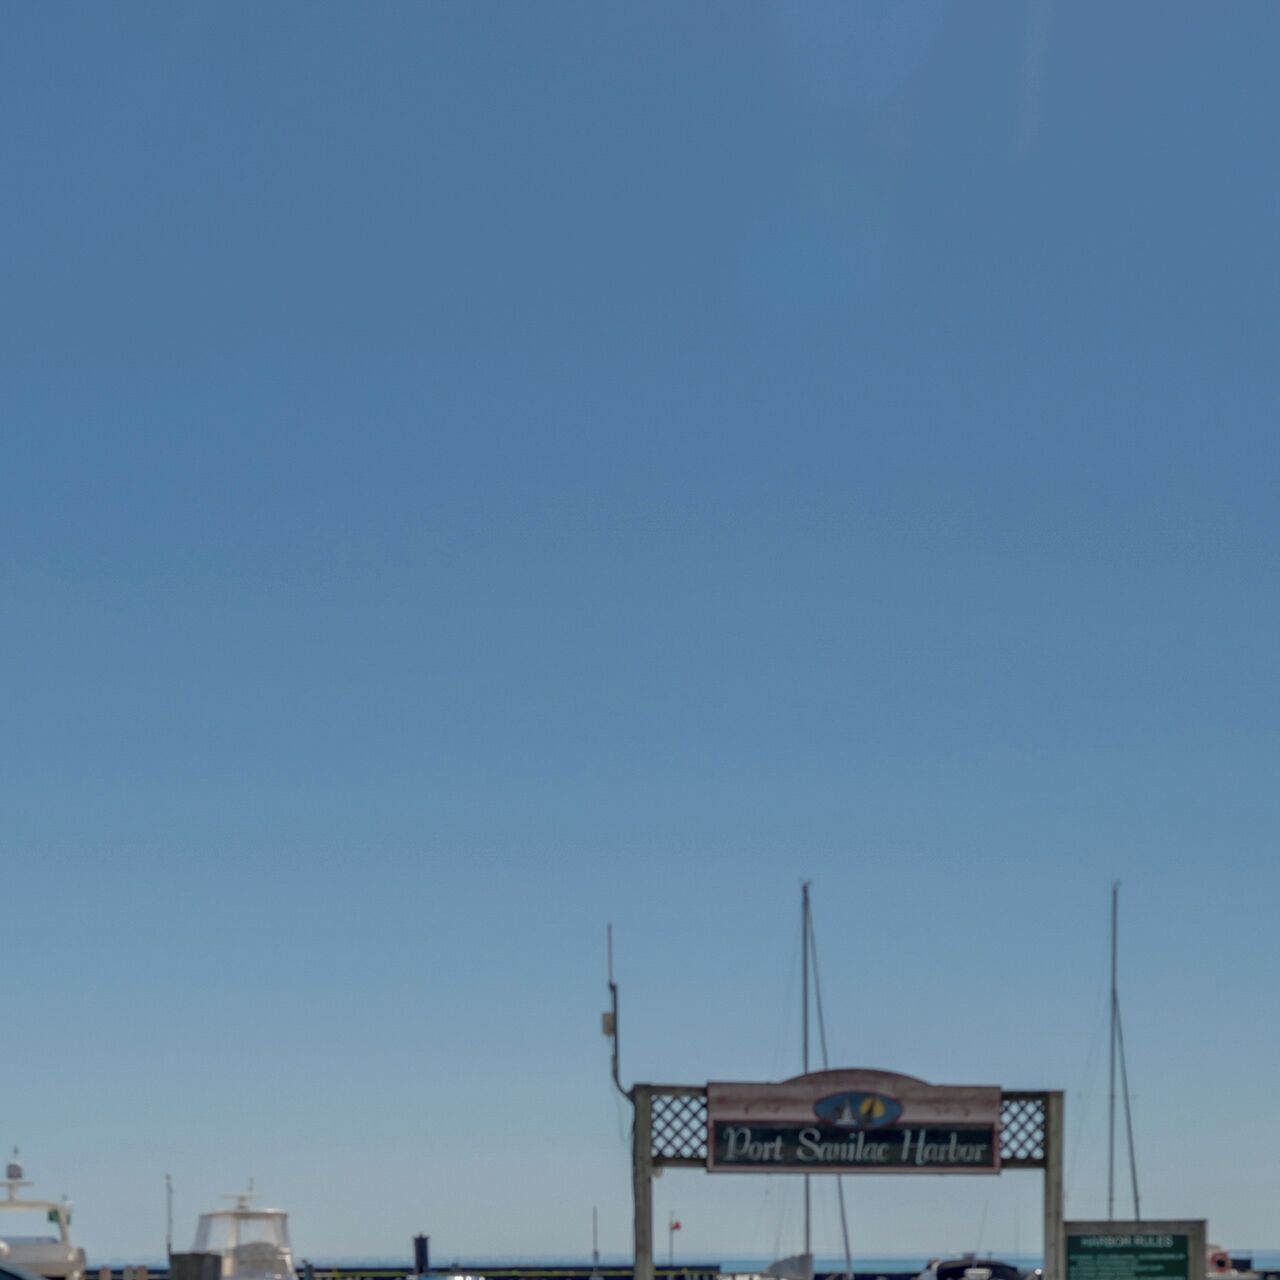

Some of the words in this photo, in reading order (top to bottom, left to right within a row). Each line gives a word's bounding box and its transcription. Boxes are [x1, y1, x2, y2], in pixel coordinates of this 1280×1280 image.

[722, 1127, 785, 1162] Port
[796, 1126, 889, 1163] Sanilac
[901, 1128, 988, 1165] Harbor
